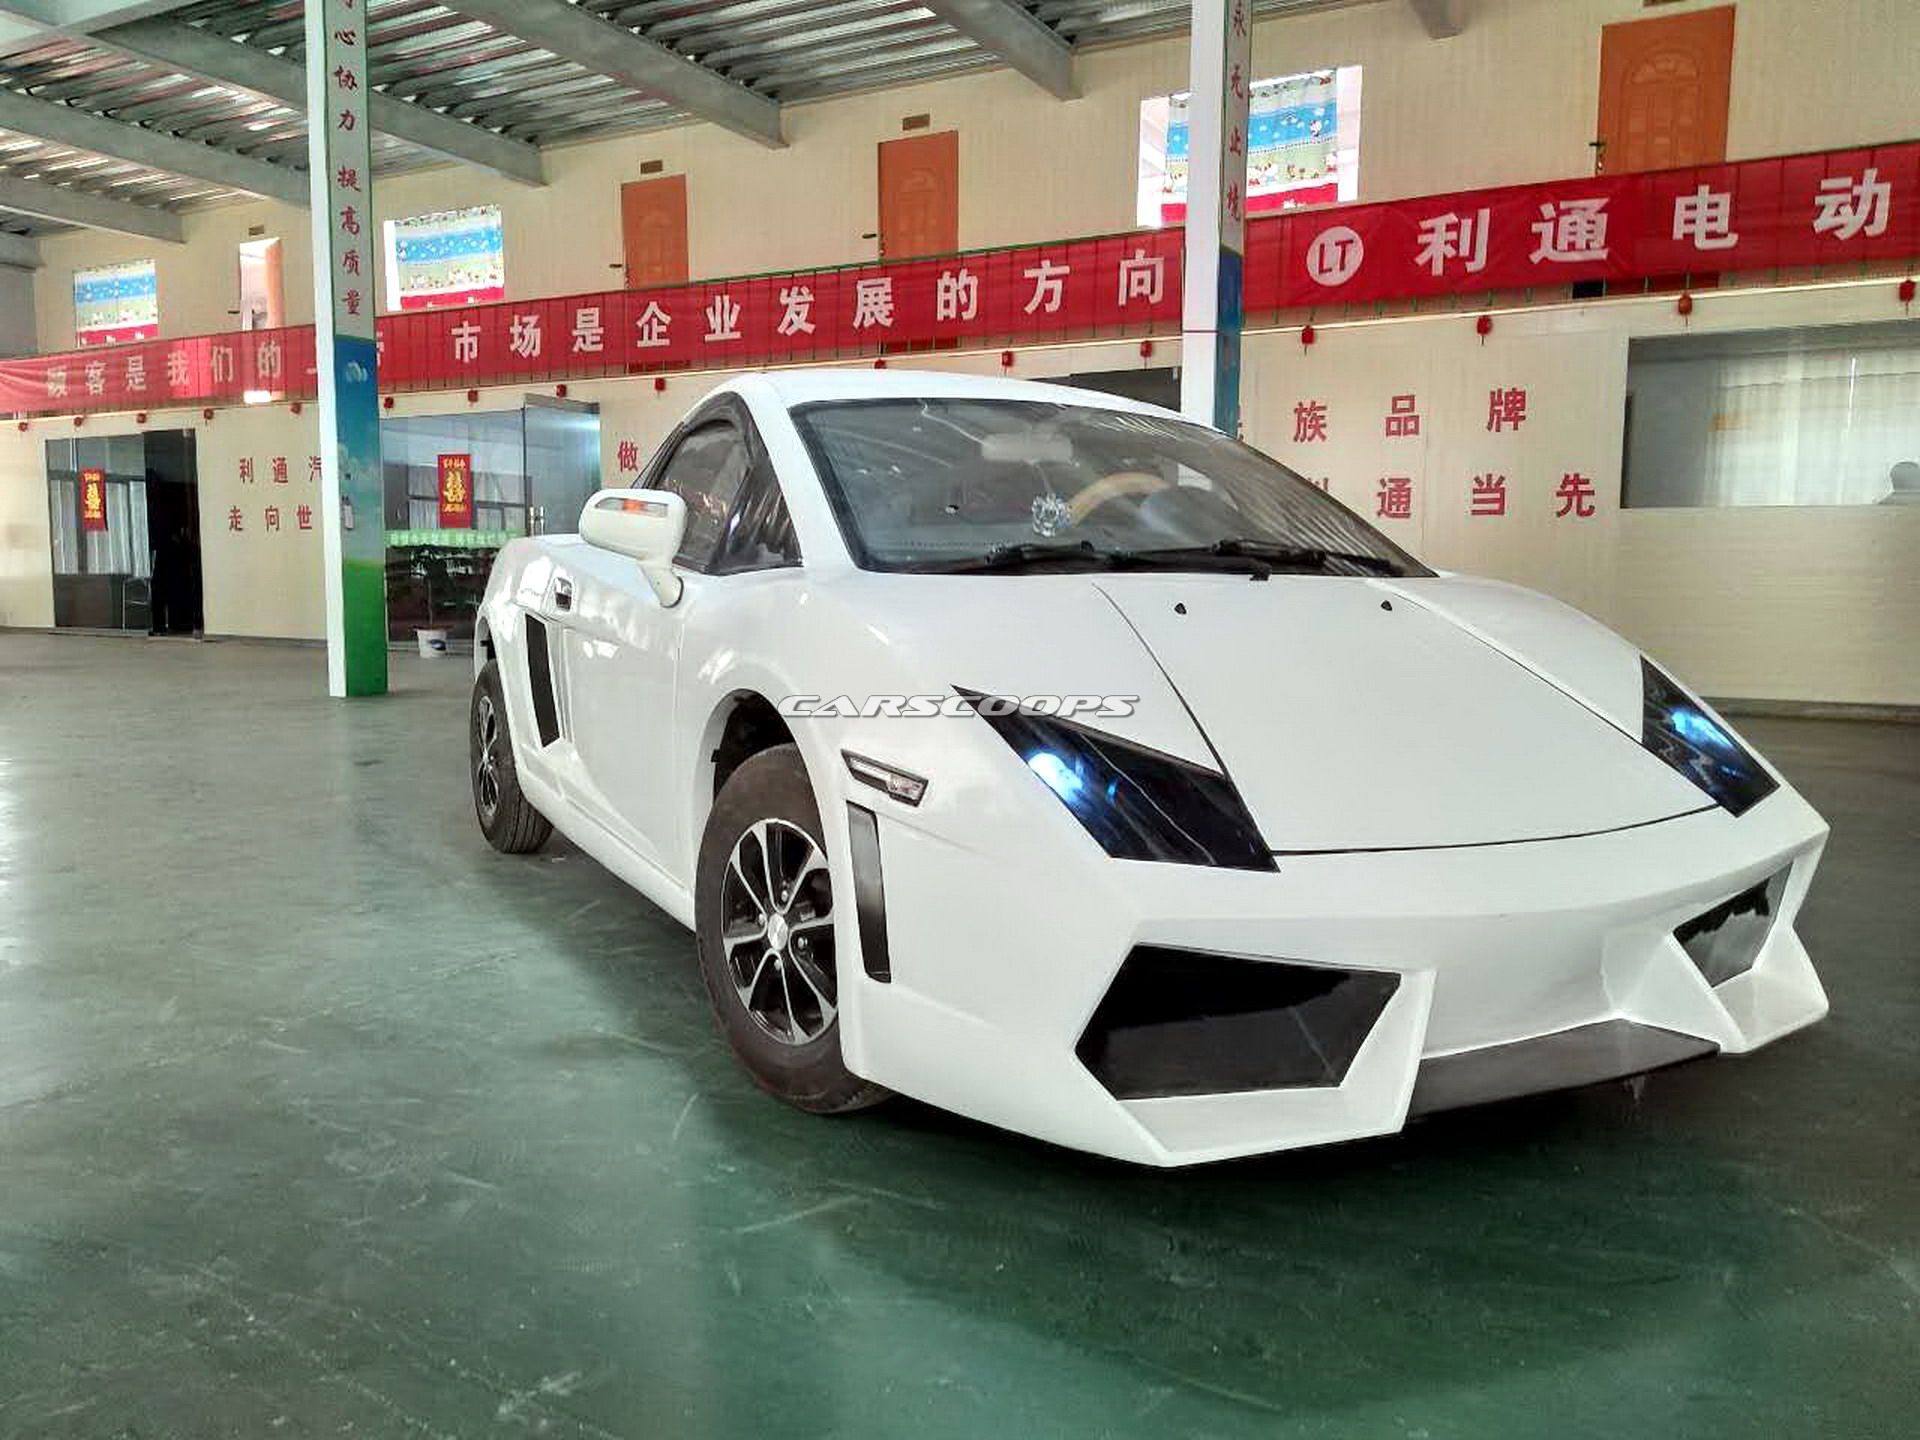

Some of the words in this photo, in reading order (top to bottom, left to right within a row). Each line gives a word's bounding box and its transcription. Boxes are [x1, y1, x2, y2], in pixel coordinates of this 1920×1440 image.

[333, 0, 358, 131] 心协力
[1414, 167, 1892, 277] 利通电动
[450, 249, 1165, 363] 市场是企业发展的方向
[1237, 387, 1527, 443] 族品牌
[617, 440, 638, 473] 做
[228, 503, 313, 532] 走向世
[1306, 472, 1596, 519] 通当先
